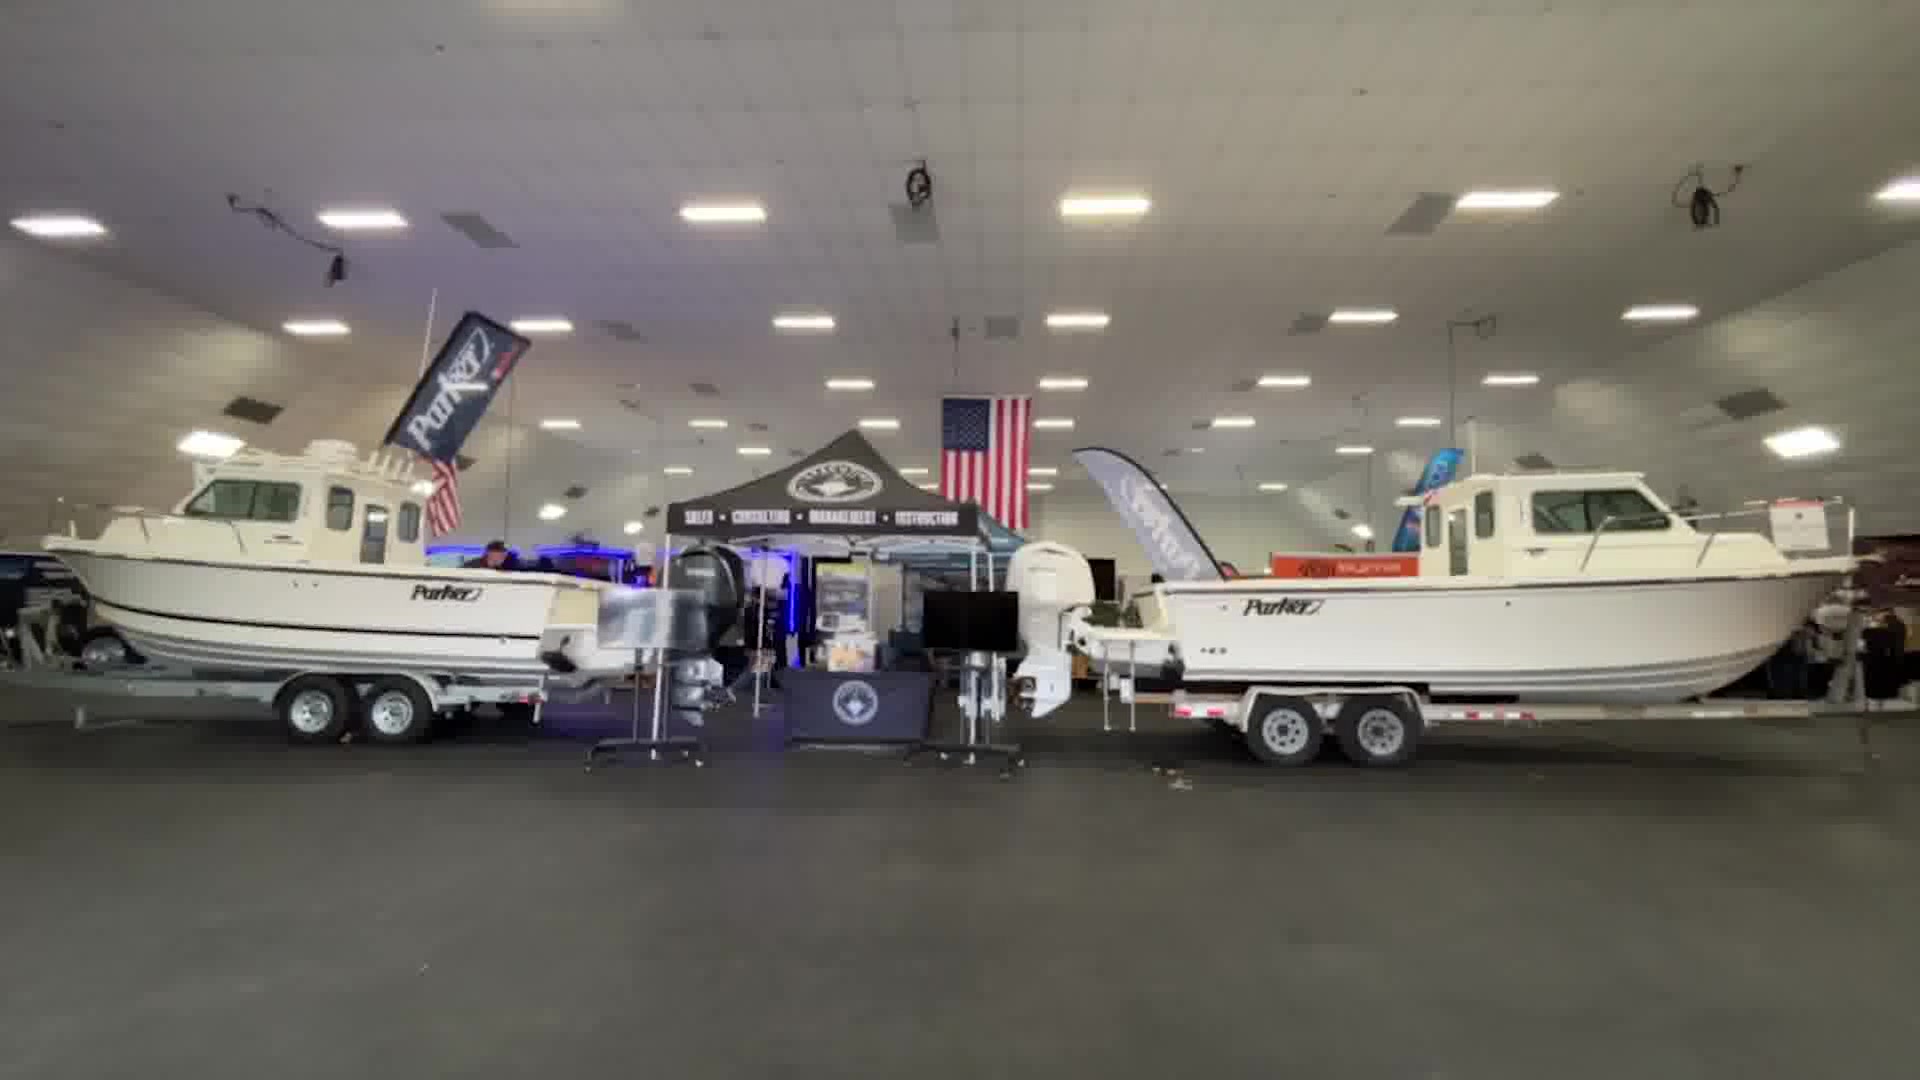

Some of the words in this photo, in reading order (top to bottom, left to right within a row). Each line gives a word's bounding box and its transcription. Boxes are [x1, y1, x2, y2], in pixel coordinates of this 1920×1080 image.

[407, 338, 489, 451] Parker
[411, 584, 476, 602] Parker
[1243, 597, 1316, 616] Parker
